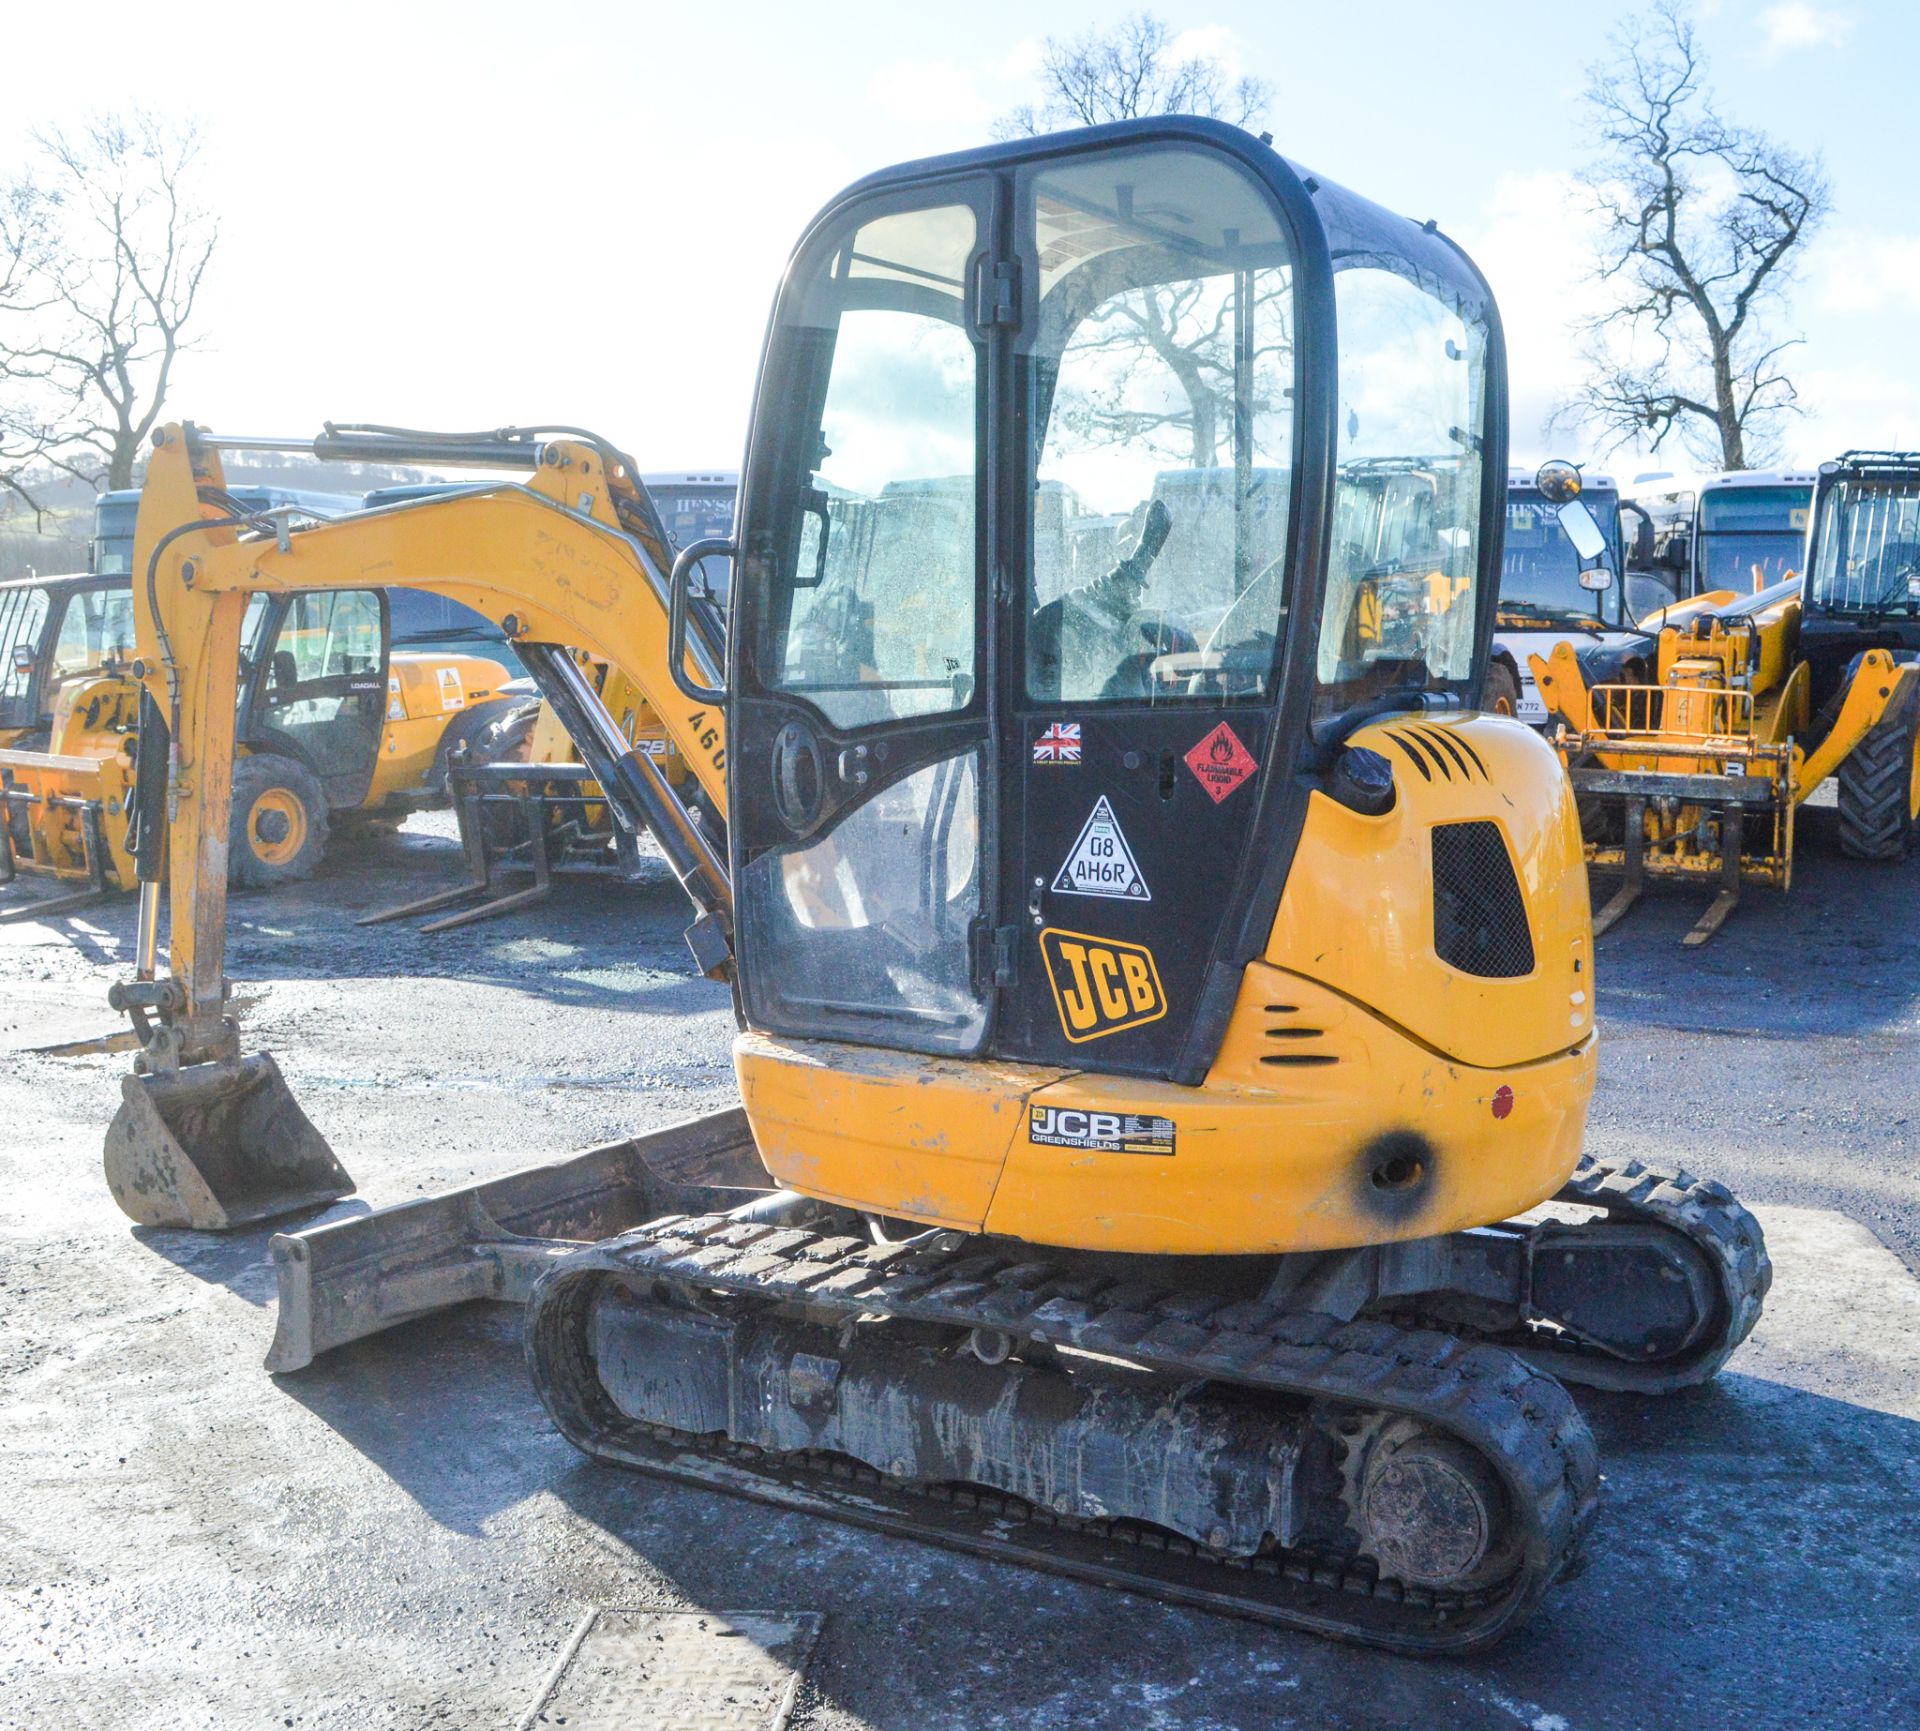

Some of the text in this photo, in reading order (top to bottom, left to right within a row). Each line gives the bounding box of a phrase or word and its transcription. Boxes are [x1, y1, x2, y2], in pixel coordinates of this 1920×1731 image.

[635, 740, 665, 755] CB
[1197, 763, 1244, 777] FLAMMABLE
[1207, 774, 1232, 784] LIQUID
[1075, 860, 1126, 885] AH6R
[1058, 940, 1157, 1031] JCB
[1031, 1109, 1121, 1141] JCB
[1031, 1133, 1121, 1151] GREENSHIELDS
